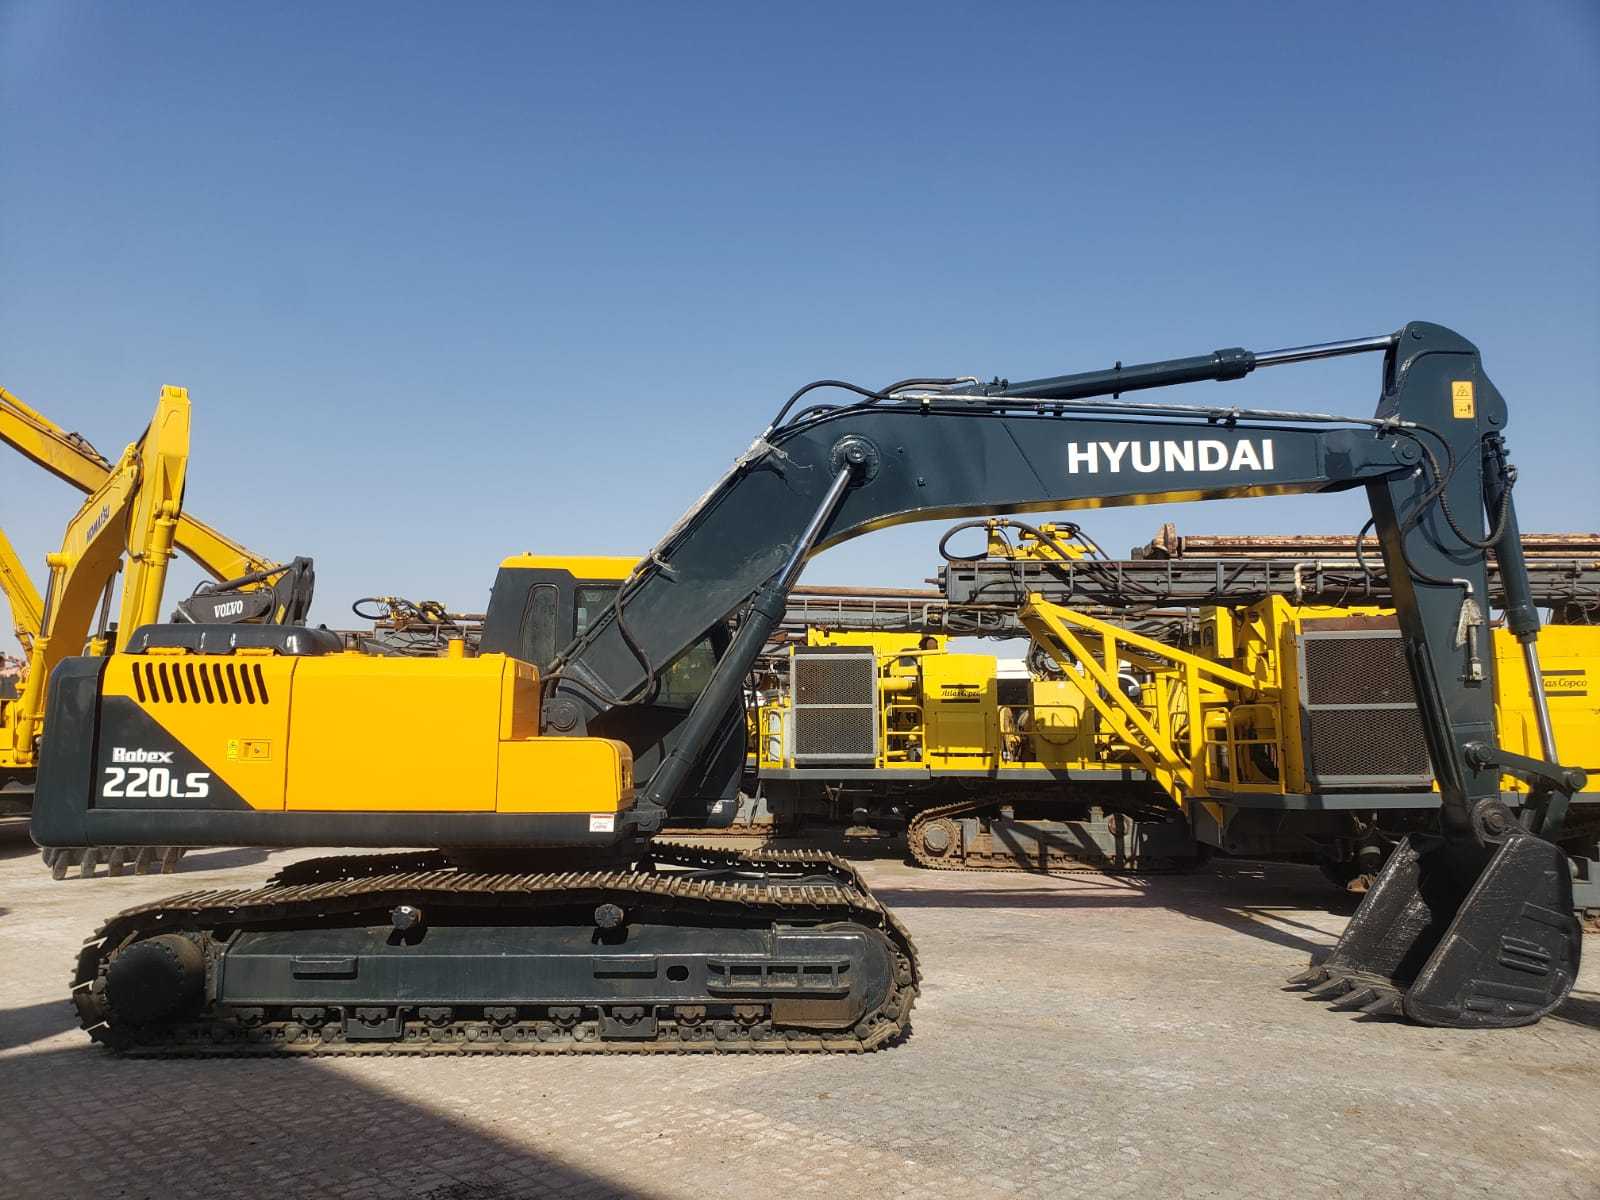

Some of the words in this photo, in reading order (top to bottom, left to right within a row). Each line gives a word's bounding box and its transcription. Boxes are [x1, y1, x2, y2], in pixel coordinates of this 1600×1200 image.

[1068, 439, 1274, 474] HYUNDAI
[86, 504, 110, 544] KOMATSU
[214, 600, 243, 618] VOLVO
[1558, 678, 1587, 688] Copco
